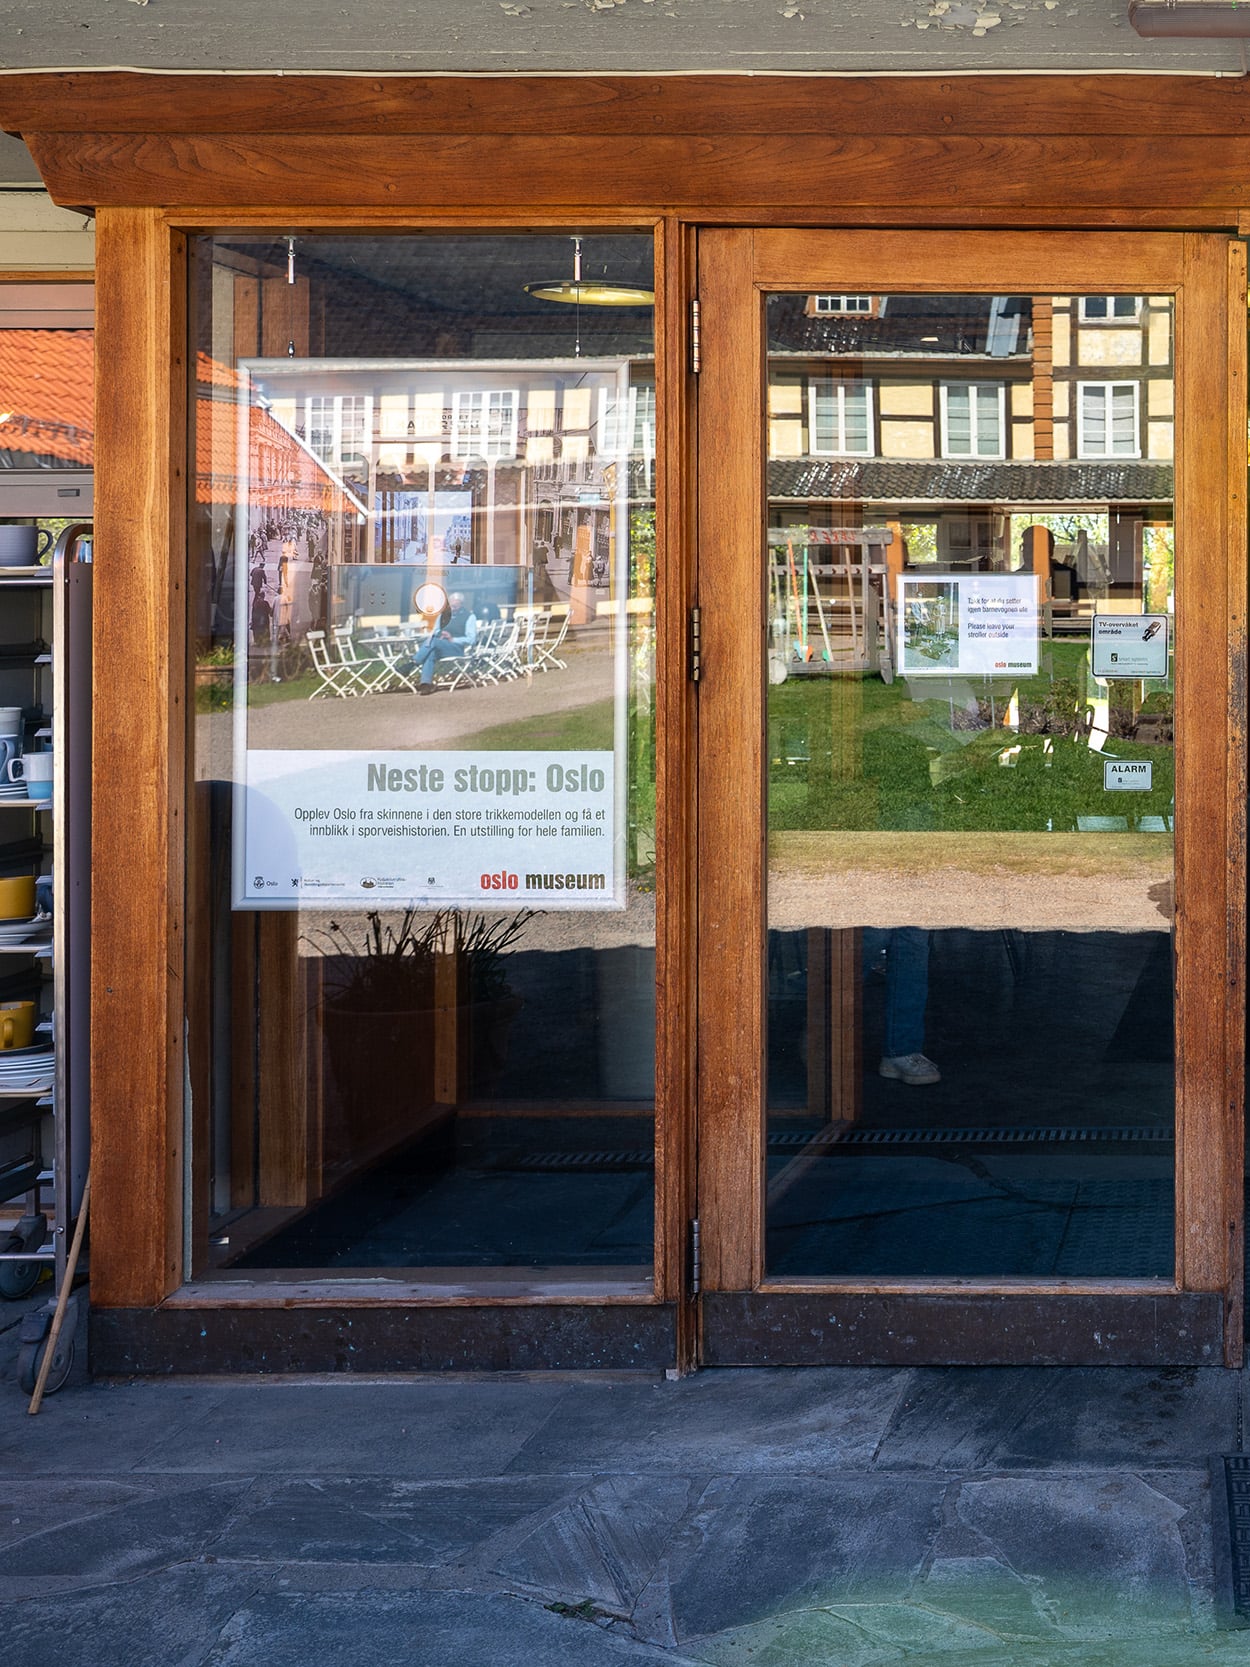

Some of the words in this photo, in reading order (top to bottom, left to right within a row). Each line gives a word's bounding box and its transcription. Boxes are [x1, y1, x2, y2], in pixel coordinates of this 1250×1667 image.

[368, 764, 444, 792] Neste
[454, 764, 536, 795] stopp:
[546, 764, 604, 792] Oslo
[295, 808, 329, 822] Opplev
[334, 808, 356, 820] Oslo
[360, 808, 374, 820] fra
[377, 808, 422, 820] skinnene
[427, 808, 429, 820] i
[434, 808, 451, 820] den
[455, 809, 482, 820] store
[485, 808, 561, 820] trikkemodellen
[565, 811, 578, 823] og
[581, 808, 592, 820] få
[596, 809, 605, 820] et
[310, 824, 348, 836] innblikk
[352, 825, 354, 836] i
[358, 824, 450, 839] sporveishistorien.
[454, 825, 466, 836] En
[471, 824, 514, 839] utstilling
[518, 824, 532, 836] for
[536, 824, 557, 836] hele
[562, 824, 604, 836] familien.
[481, 871, 518, 890] oslo
[526, 872, 605, 890] museum
